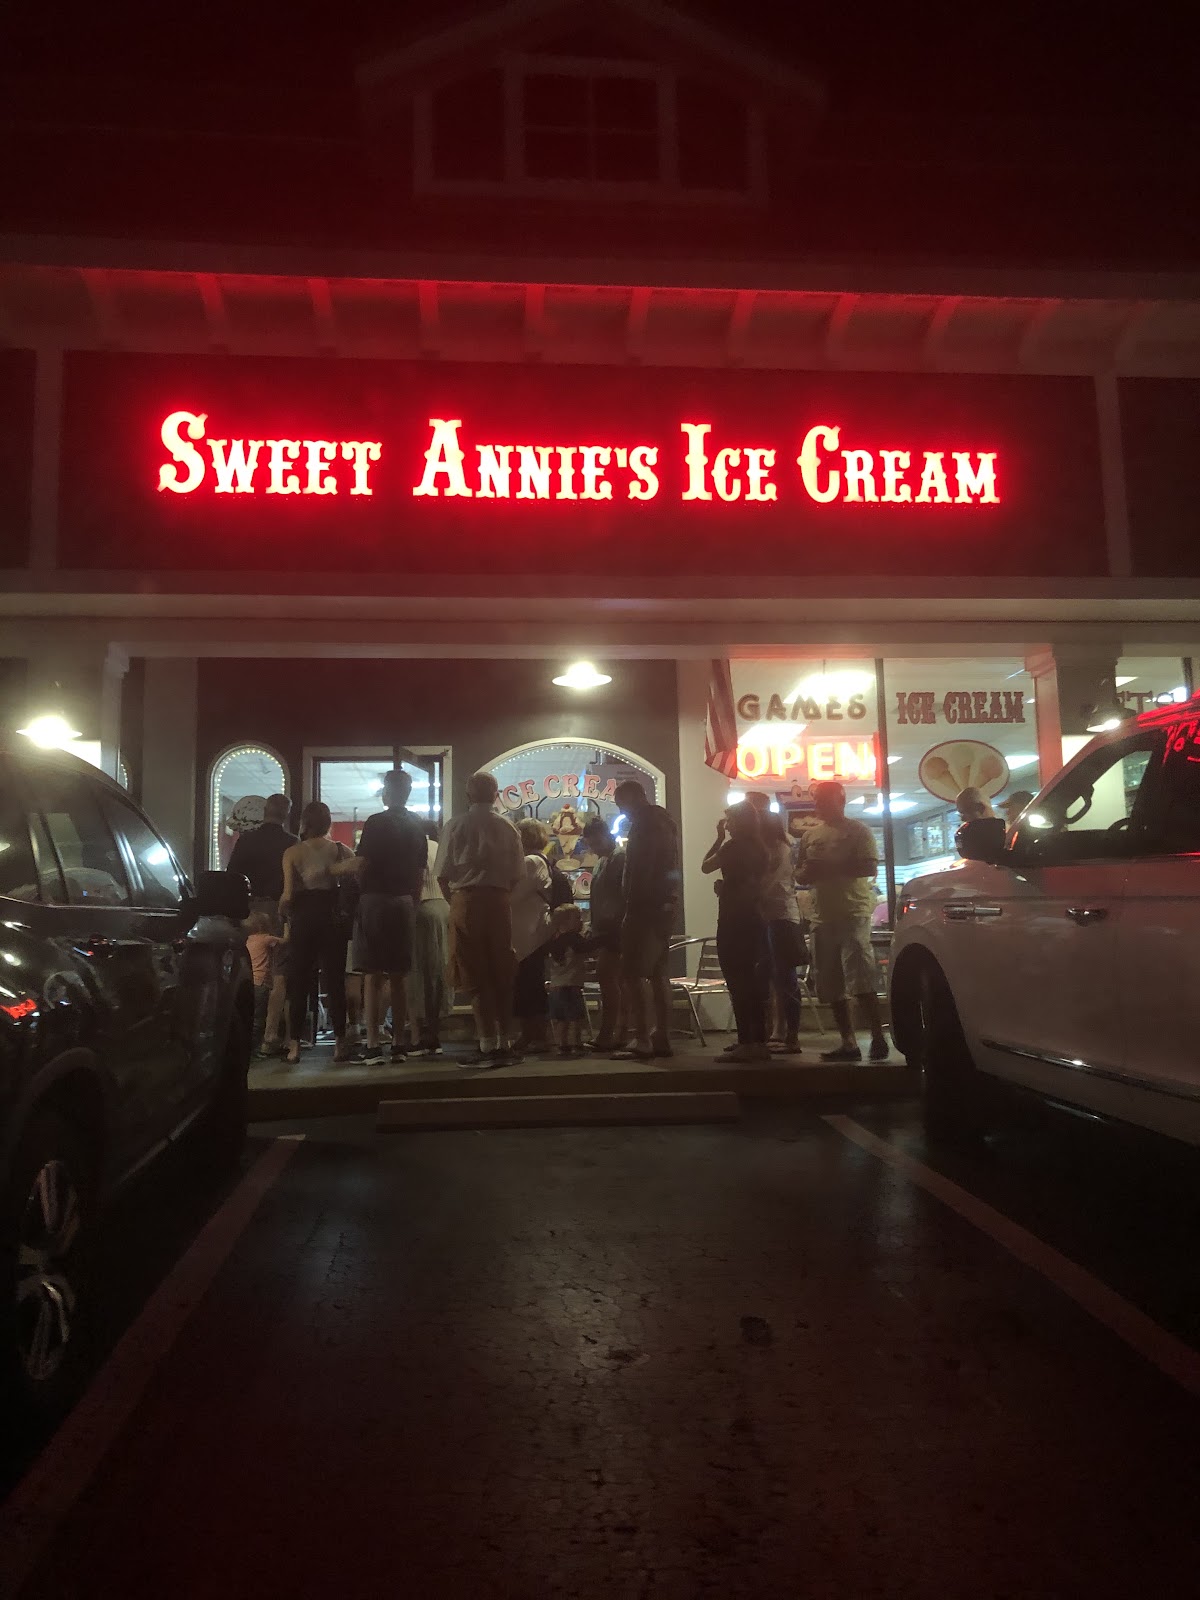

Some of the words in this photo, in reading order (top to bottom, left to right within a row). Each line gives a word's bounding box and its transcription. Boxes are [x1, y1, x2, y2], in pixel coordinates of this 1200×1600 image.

[737, 692, 867, 721] GAMES
[896, 692, 937, 725] ICE
[943, 691, 1026, 724] CREAM
[735, 741, 877, 781] OPEN
[543, 773, 617, 803] CREA
